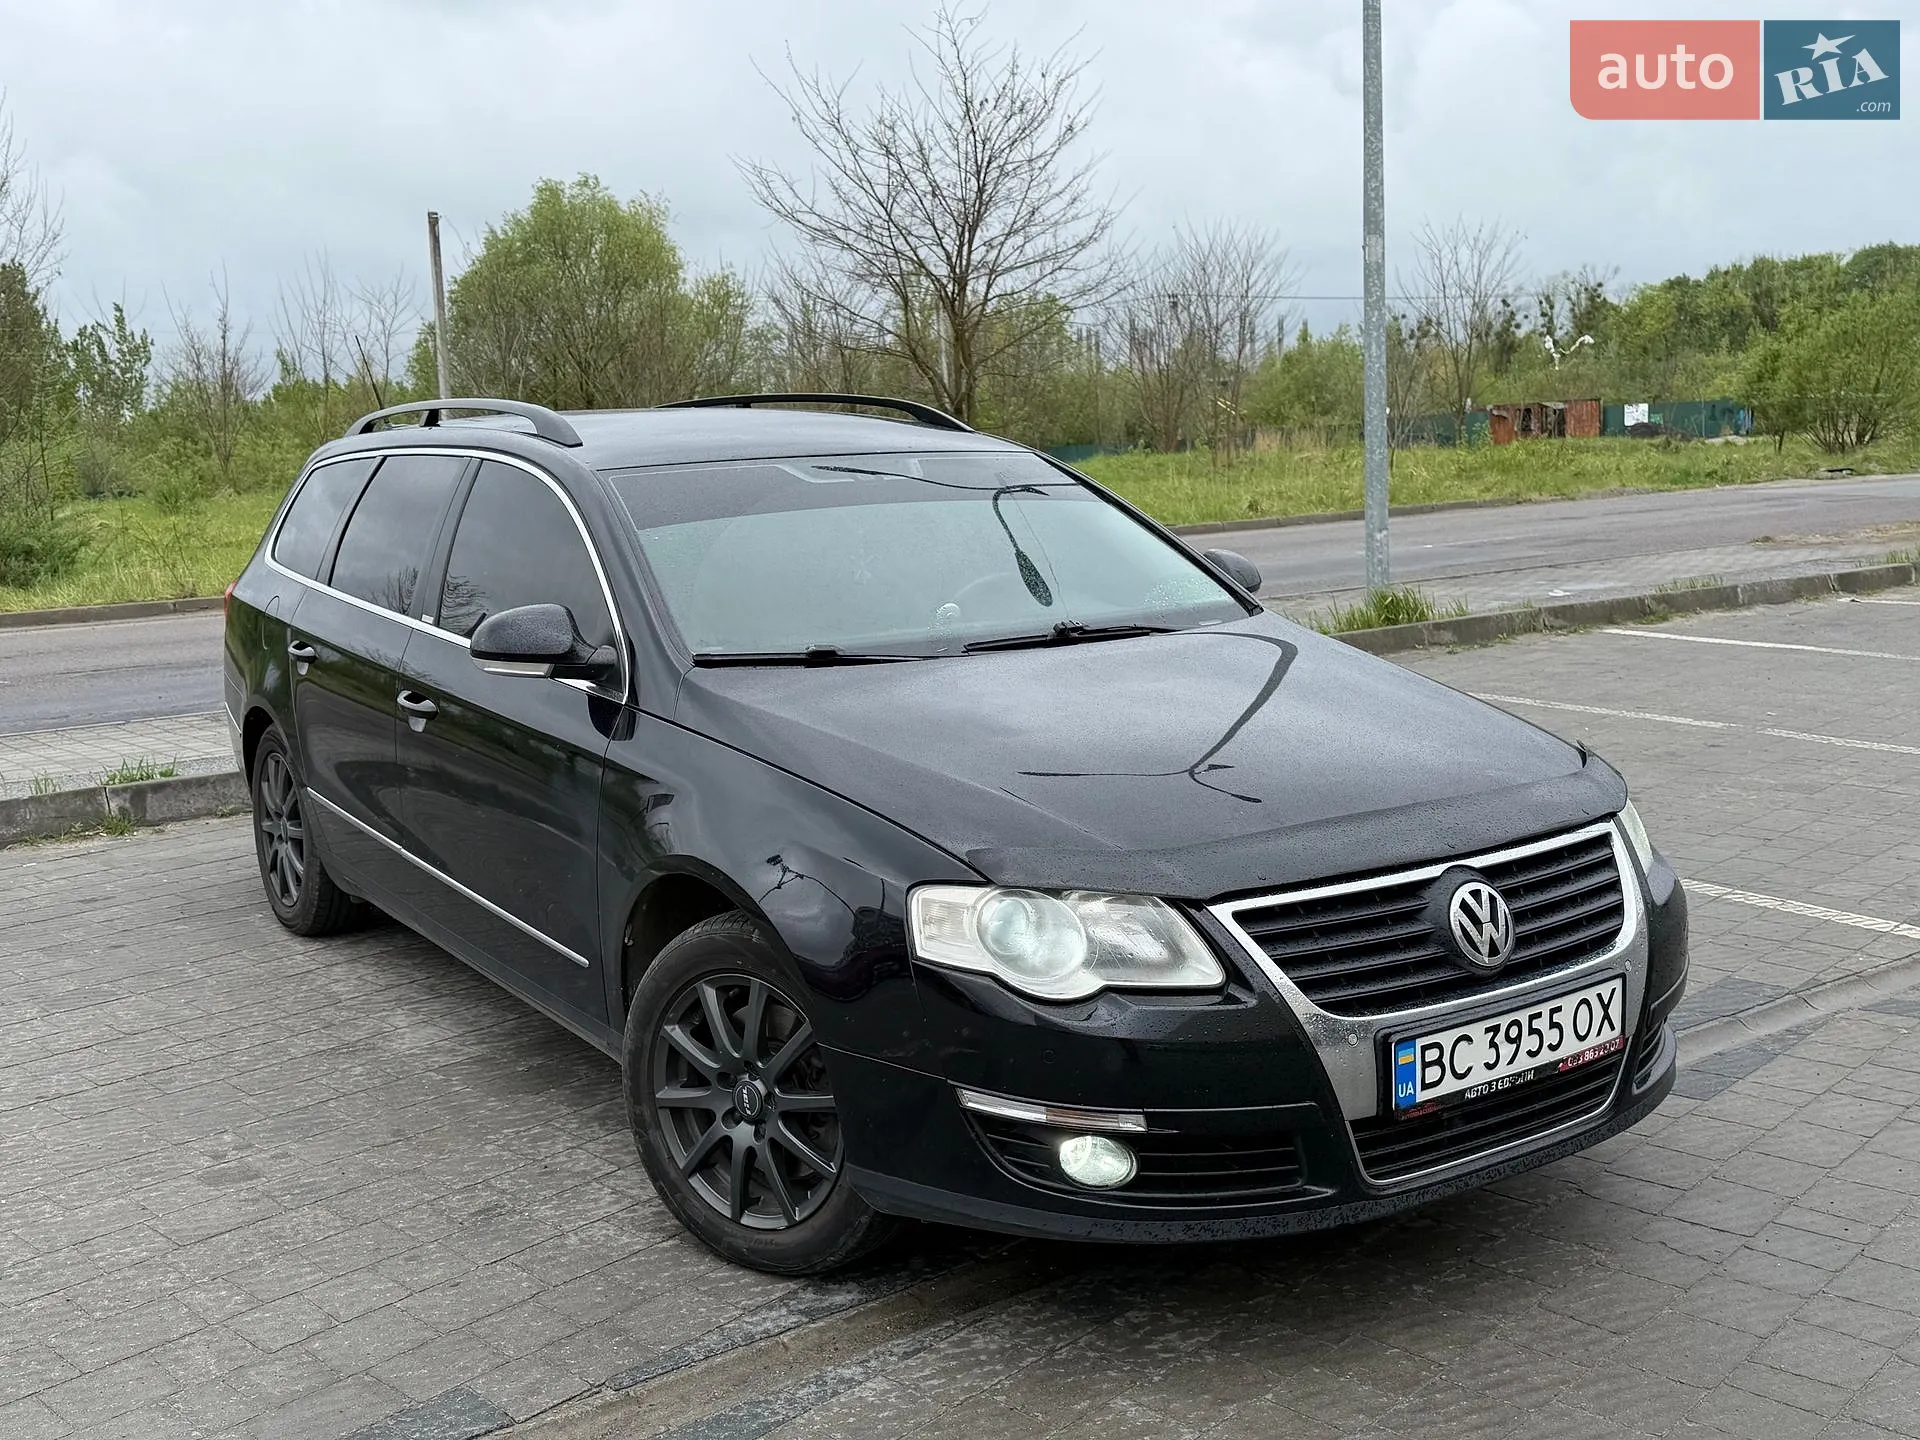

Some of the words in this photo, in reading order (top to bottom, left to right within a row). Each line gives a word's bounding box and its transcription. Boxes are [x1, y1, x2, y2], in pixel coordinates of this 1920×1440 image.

[1420, 1033, 1474, 1092] BC
[1483, 1004, 1564, 1071] 3955
[1573, 986, 1617, 1042] OX
[1398, 1080, 1415, 1098] UA
